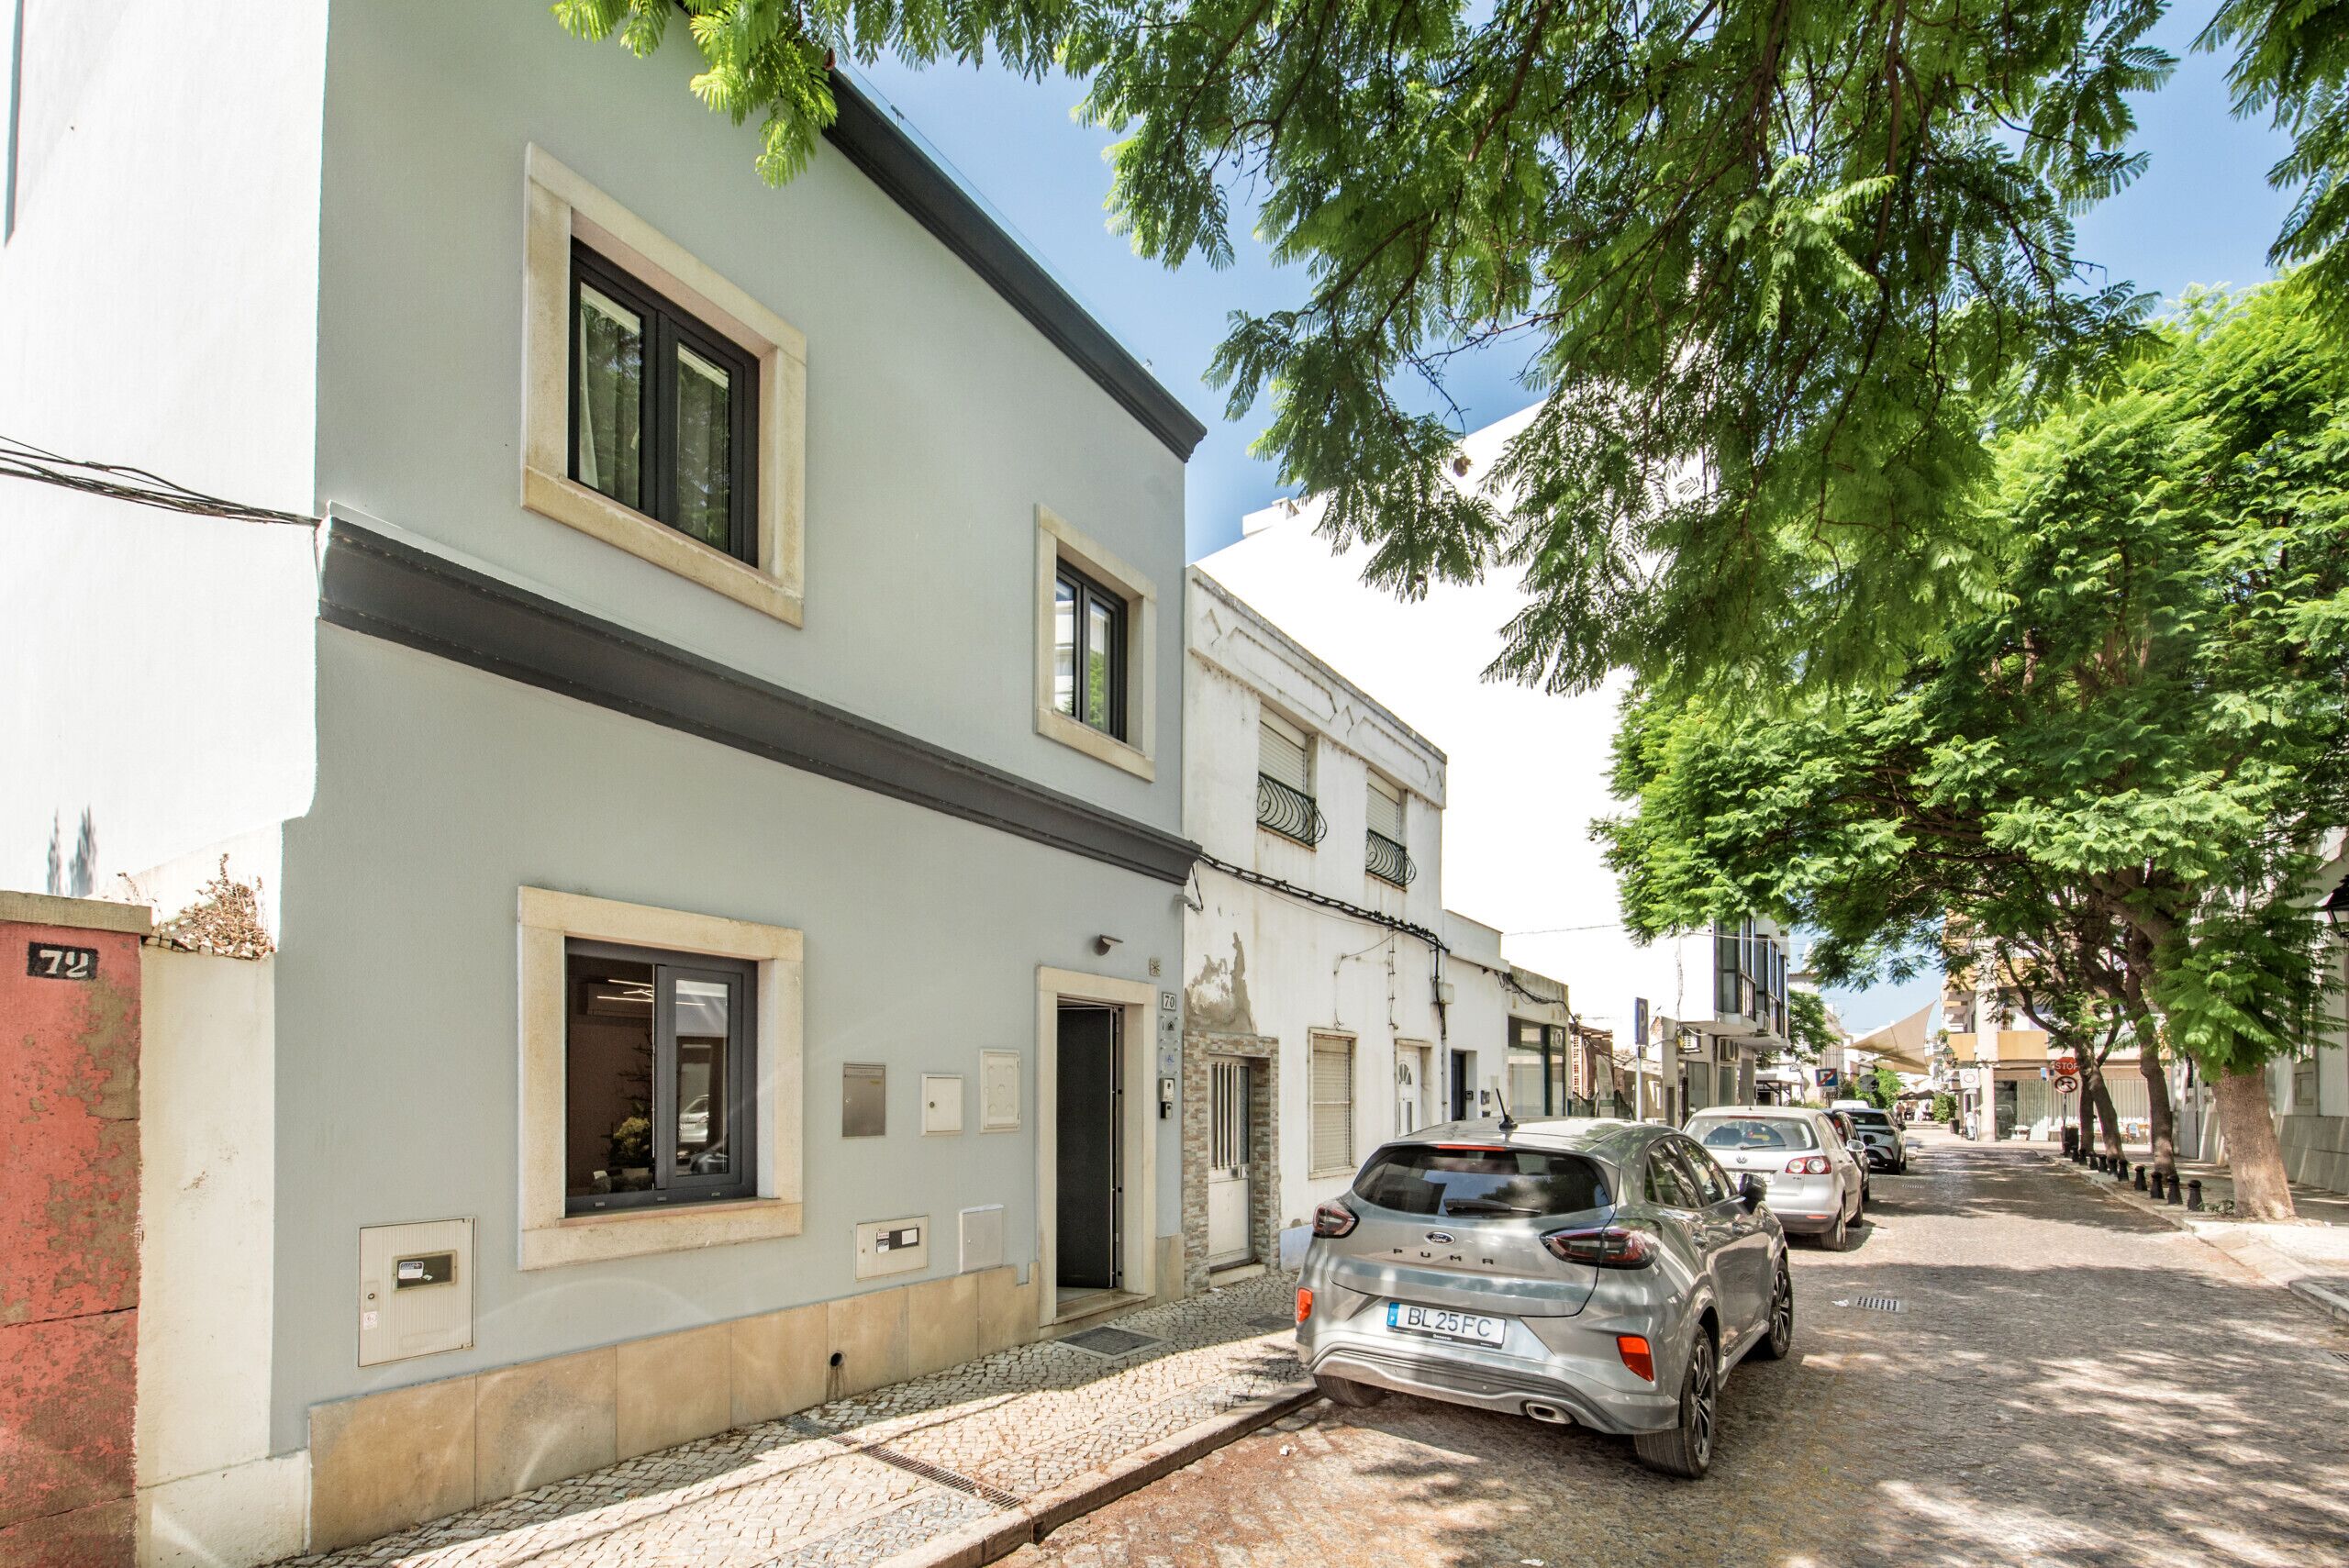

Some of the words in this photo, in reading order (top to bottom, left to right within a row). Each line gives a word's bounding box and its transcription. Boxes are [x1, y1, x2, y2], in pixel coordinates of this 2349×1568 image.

[39, 950, 89, 977] 72
[1164, 995, 1174, 1007] 70
[1638, 1003, 1646, 1040] P
[1393, 1248, 1494, 1264] PUMA
